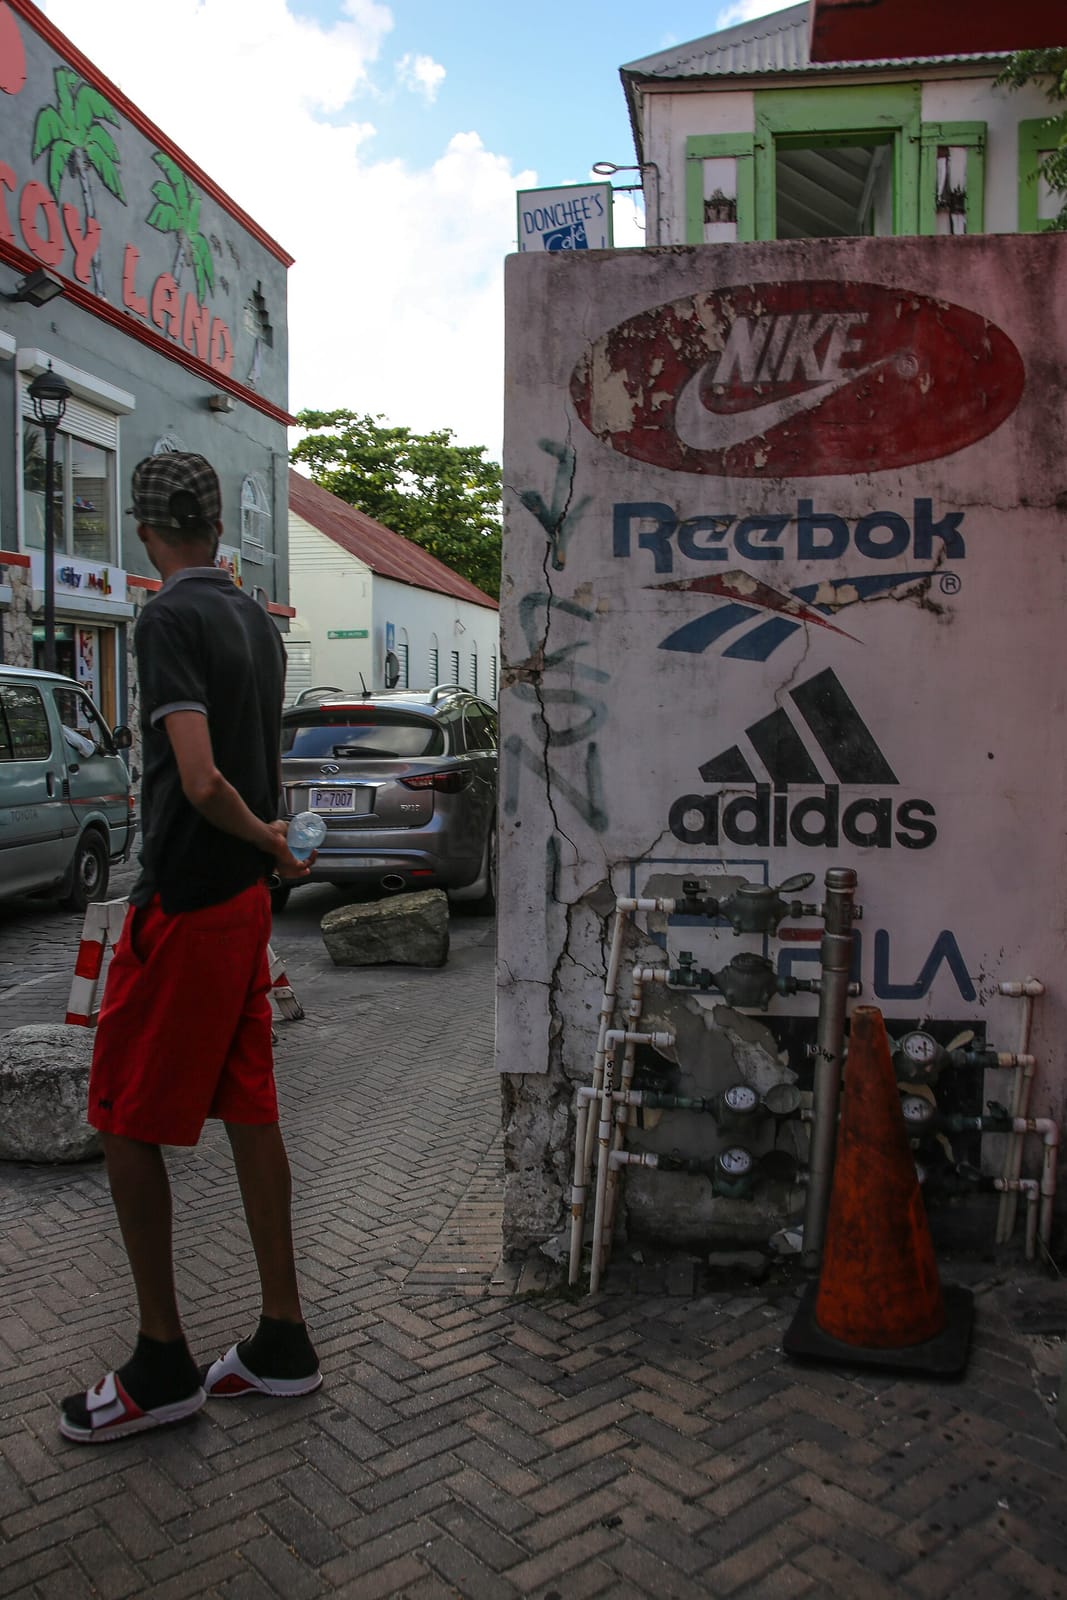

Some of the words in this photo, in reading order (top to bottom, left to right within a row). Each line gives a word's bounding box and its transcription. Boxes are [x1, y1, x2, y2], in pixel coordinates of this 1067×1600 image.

[523, 193, 604, 234] DONCHEE'S
[122, 243, 233, 377] LAND
[712, 312, 869, 383] NIKE
[612, 498, 966, 573] Reebok
[668, 783, 938, 850] adidas
